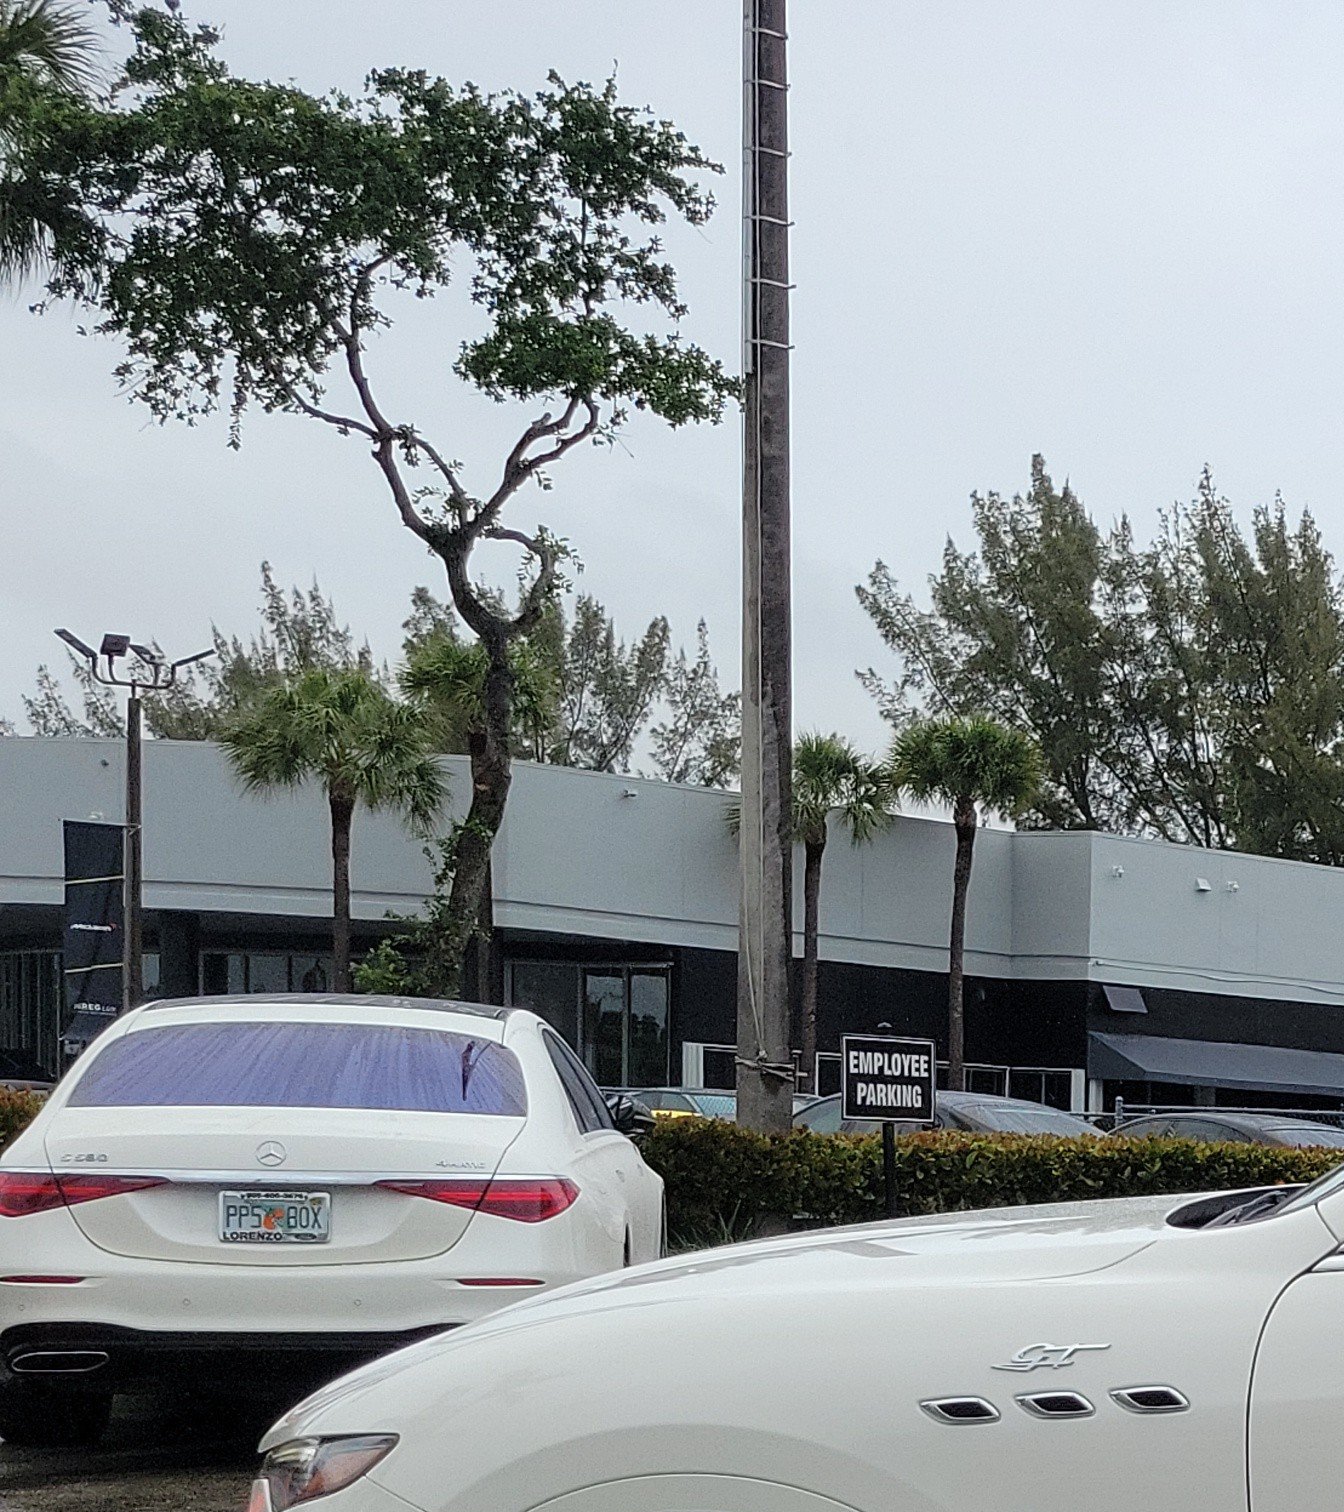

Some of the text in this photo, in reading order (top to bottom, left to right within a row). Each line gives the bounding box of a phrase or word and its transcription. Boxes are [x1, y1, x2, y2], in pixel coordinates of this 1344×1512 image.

[849, 1050, 929, 1077] EMPLOYEE
[856, 1082, 922, 1108] PARKING
[223, 1232, 283, 1241] LORENZO
